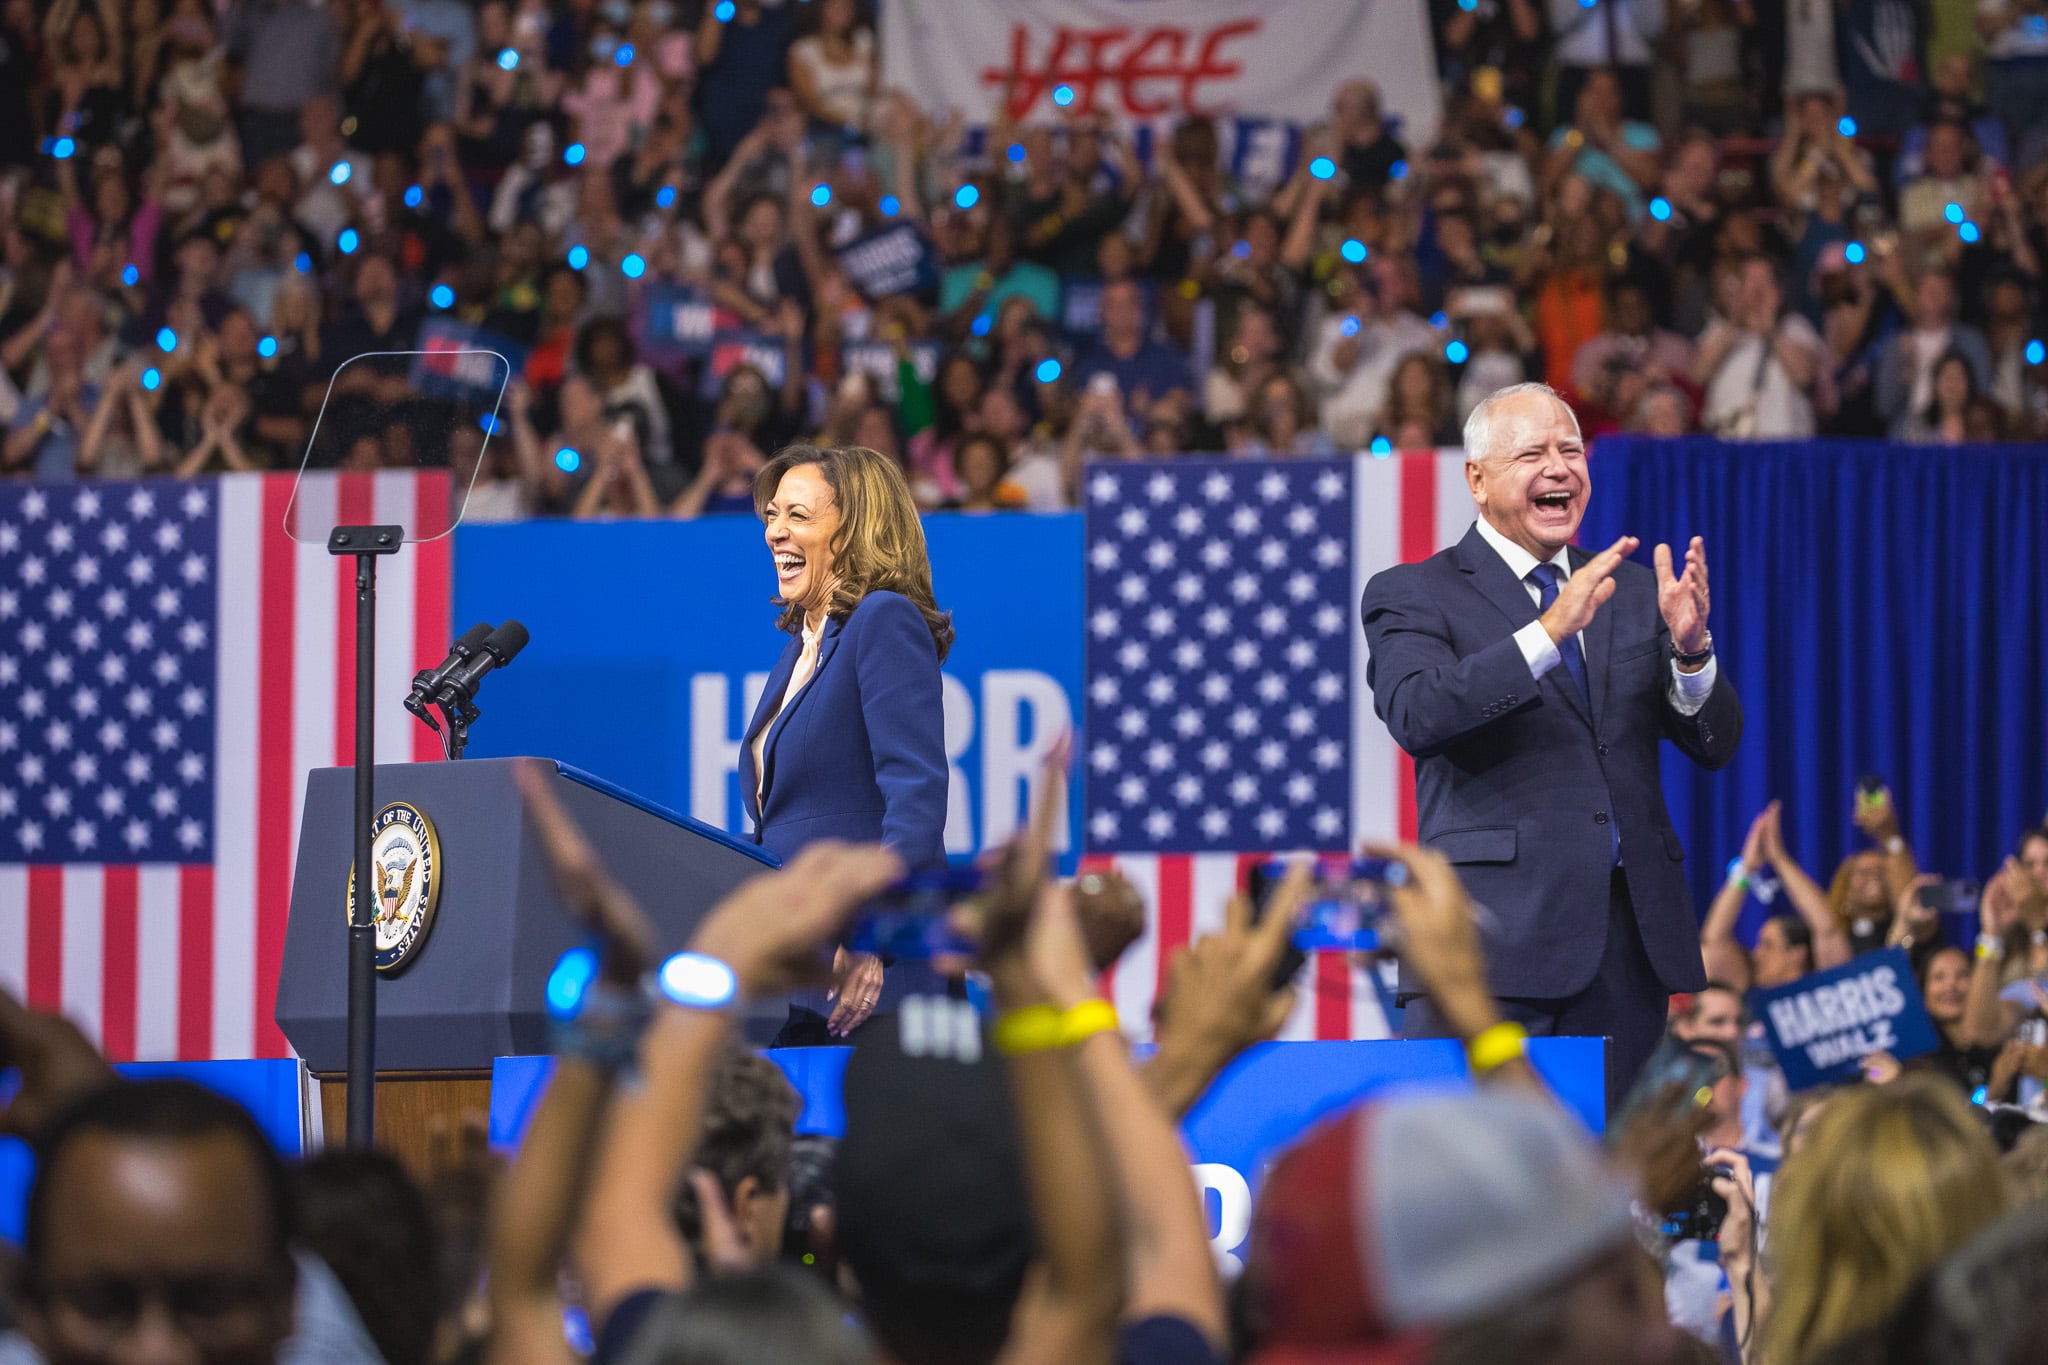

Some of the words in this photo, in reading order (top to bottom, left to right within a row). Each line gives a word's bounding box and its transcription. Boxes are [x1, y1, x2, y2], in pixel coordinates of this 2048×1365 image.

[383, 810, 395, 825] OF
[396, 809, 412, 824] THE
[412, 816, 431, 883] UNITED
[398, 894, 429, 957] STATES
[1767, 965, 1905, 1049] HARRIS
[1806, 1019, 1898, 1069] WALZ
